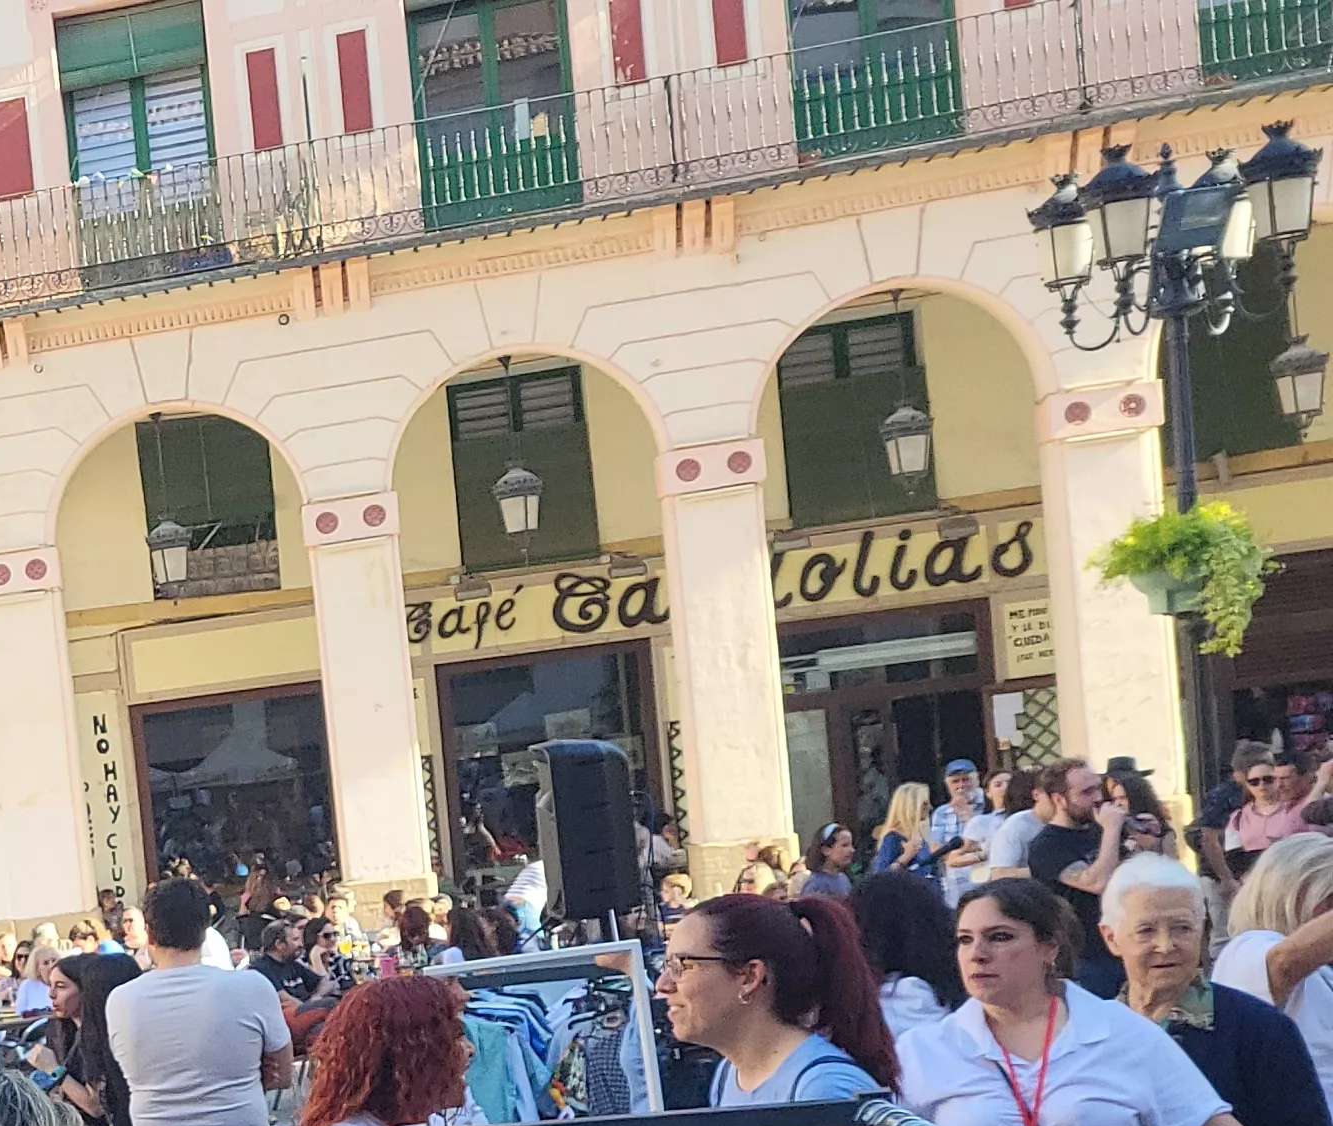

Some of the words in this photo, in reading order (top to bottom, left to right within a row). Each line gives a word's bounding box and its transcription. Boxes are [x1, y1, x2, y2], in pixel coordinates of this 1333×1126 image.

[92, 713, 109, 755] NO
[103, 760, 121, 824] HAY
[106, 833, 126, 904] CIUD
